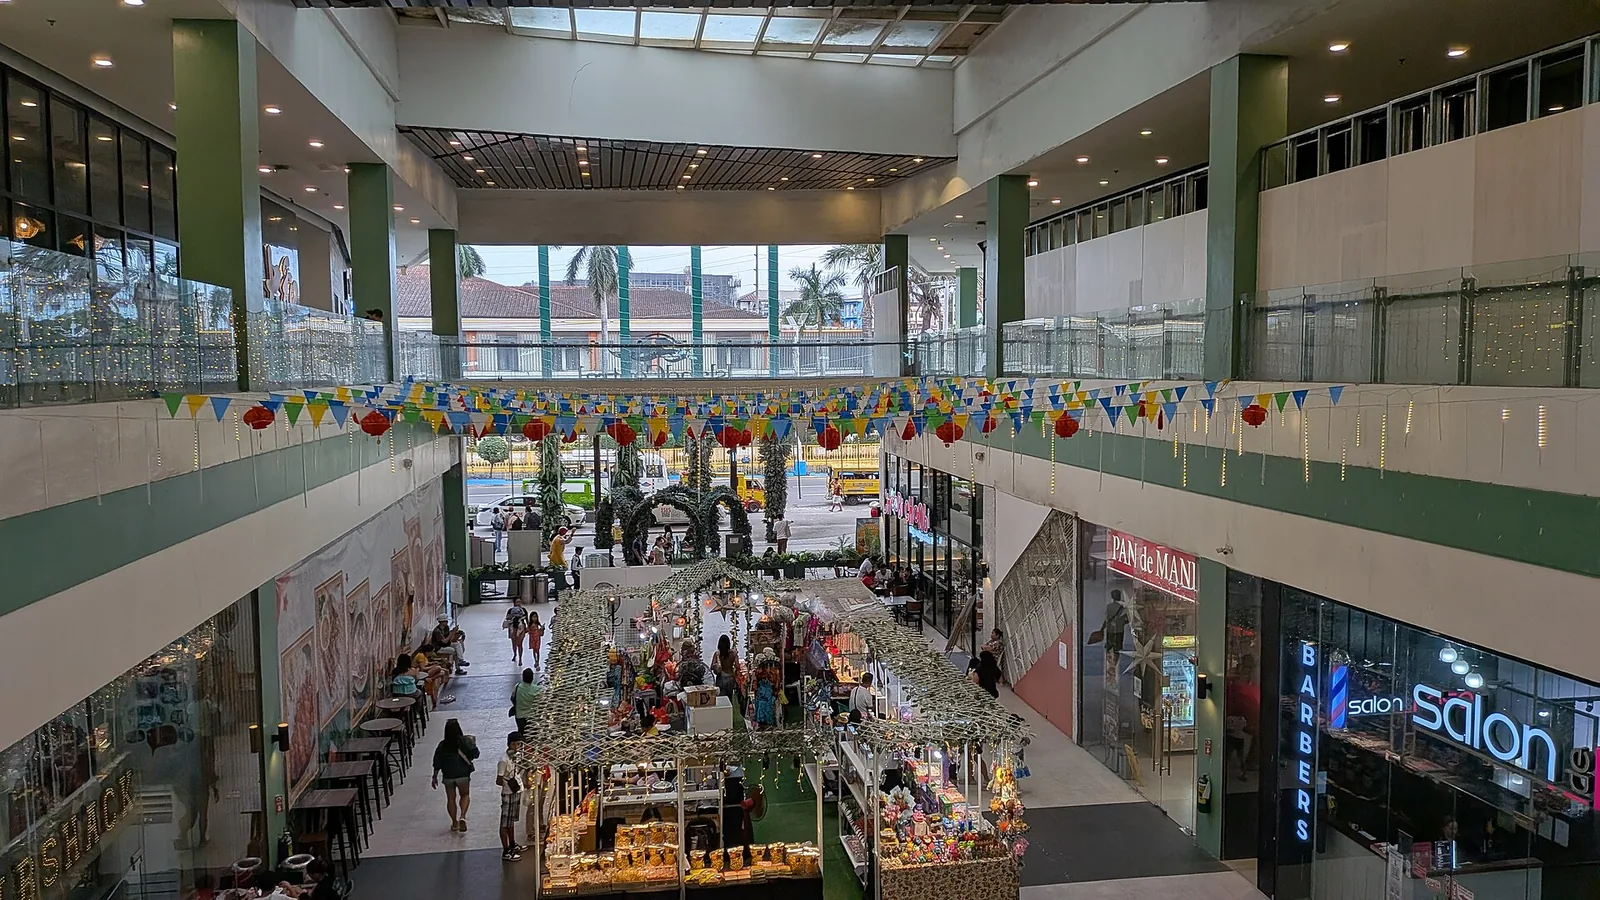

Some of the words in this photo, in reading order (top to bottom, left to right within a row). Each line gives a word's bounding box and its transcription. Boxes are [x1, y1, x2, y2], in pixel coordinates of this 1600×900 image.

[1112, 534, 1138, 568] PAN
[1140, 546, 1154, 574] de
[1156, 549, 1198, 591] MANI
[1297, 643, 1315, 841] BARBERS
[1348, 695, 1403, 715] salon
[1412, 683, 1557, 783] salon
